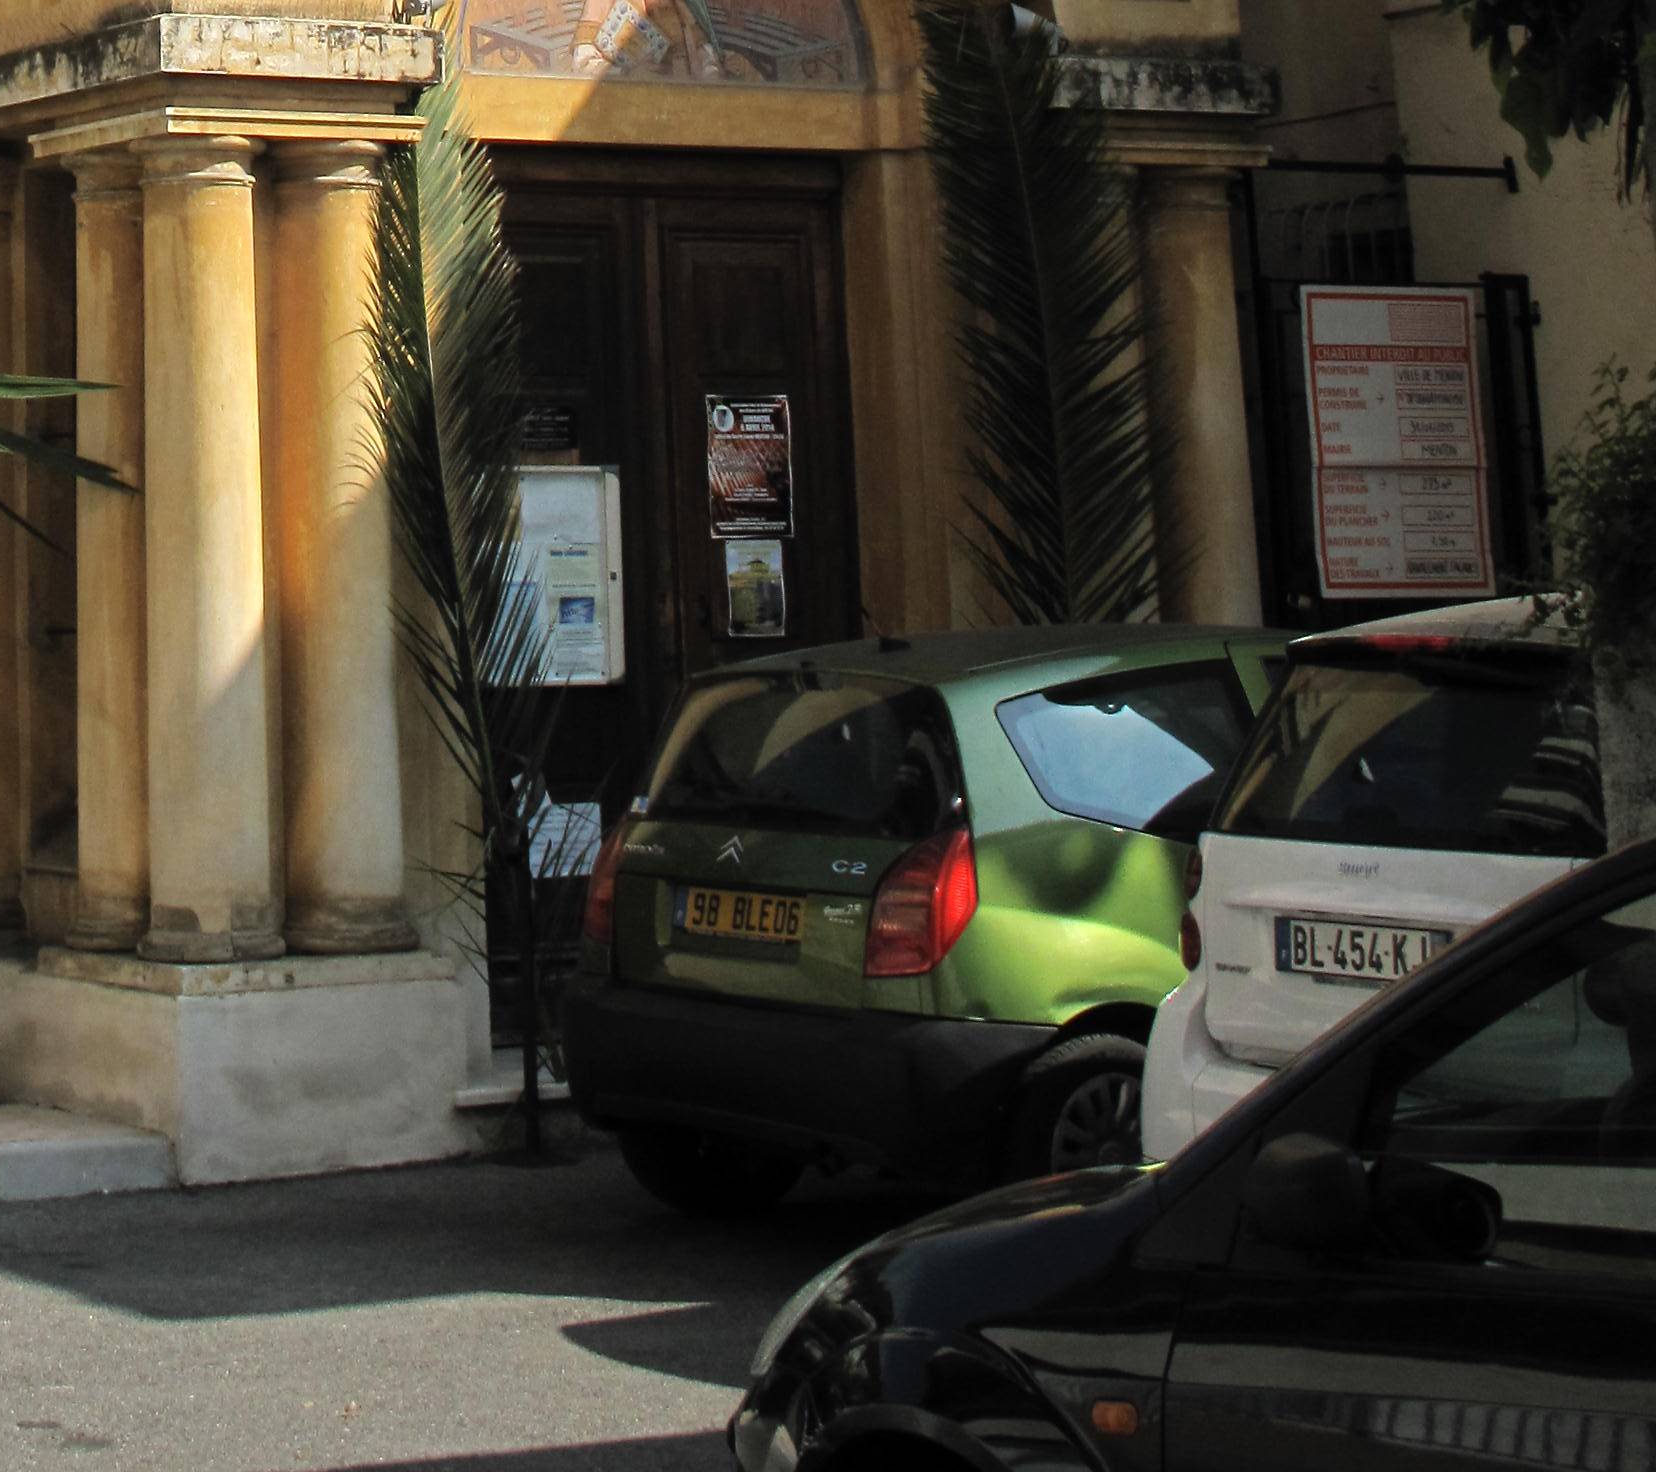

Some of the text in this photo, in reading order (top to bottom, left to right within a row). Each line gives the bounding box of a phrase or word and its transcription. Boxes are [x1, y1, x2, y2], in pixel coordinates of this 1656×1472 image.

[1316, 347, 1367, 360] CHANTIER
[1370, 347, 1414, 360] INTERDIT
[1417, 348, 1431, 360] AU
[1321, 422, 1341, 433] DATE
[831, 859, 869, 875] C2
[693, 892, 721, 927] 98
